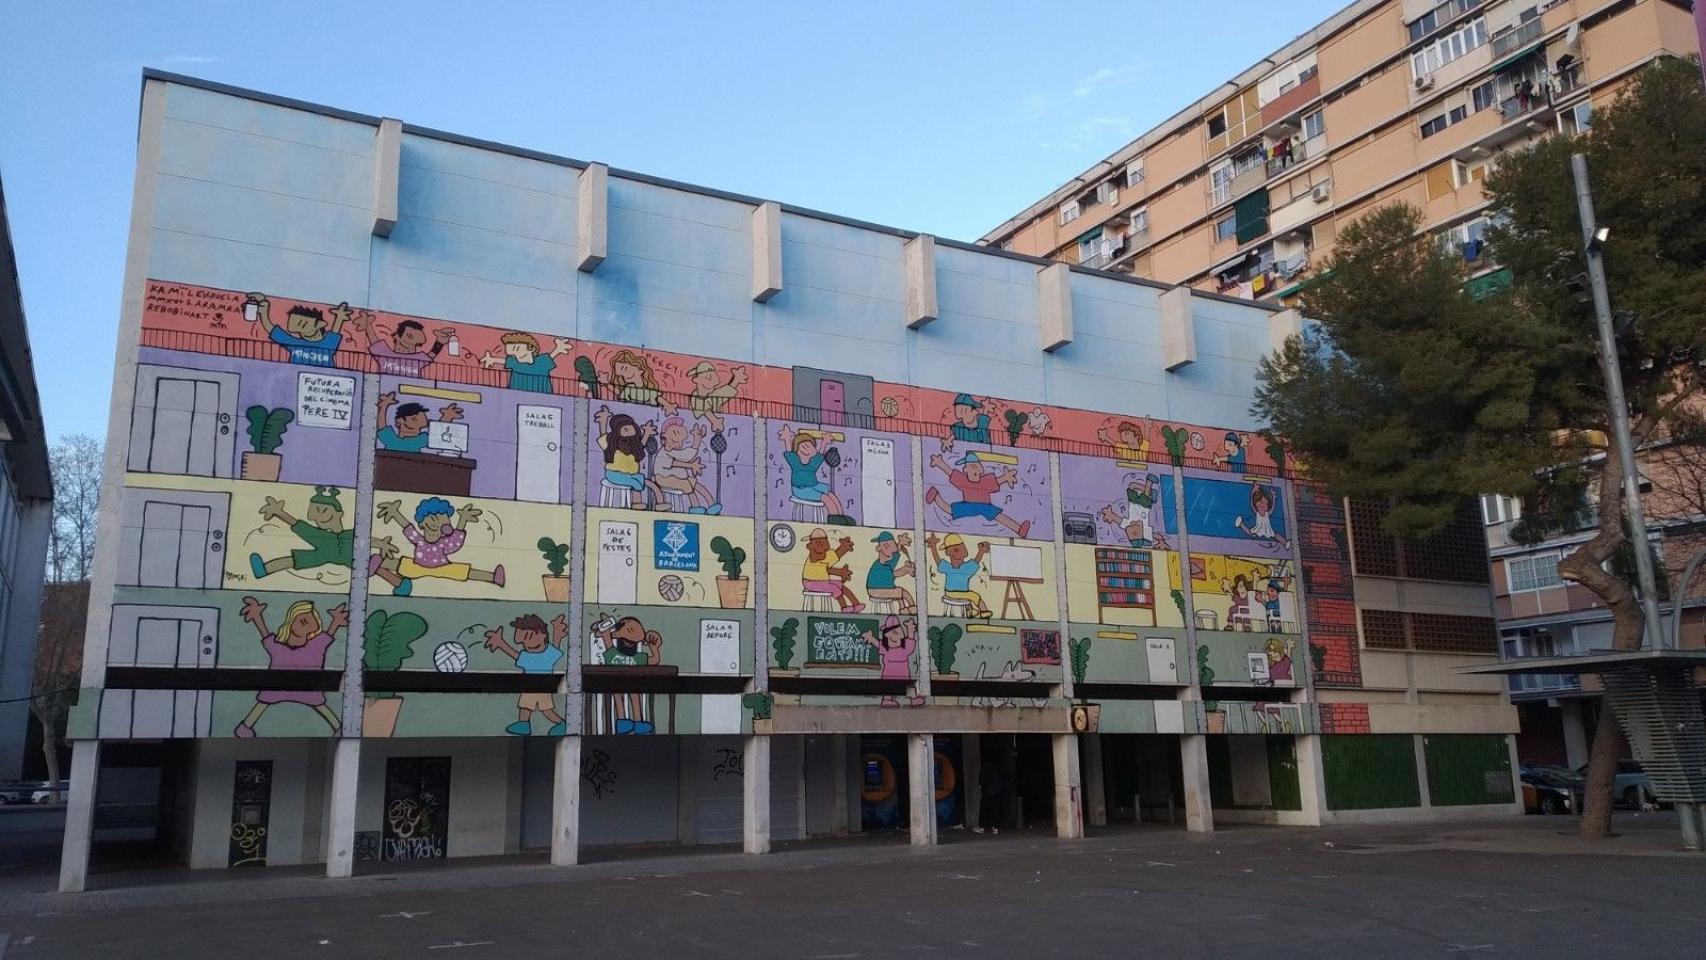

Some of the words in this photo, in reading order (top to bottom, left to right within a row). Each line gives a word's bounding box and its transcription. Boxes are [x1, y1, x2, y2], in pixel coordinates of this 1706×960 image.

[147, 303, 209, 319] REBOBINART
[303, 377, 340, 388] FUTURA
[302, 404, 329, 418] PERE
[333, 408, 349, 420] IV
[524, 420, 555, 429] TREBALL
[612, 536, 624, 544] DE
[602, 543, 632, 552] FESTES
[814, 621, 860, 636] VOLEM
